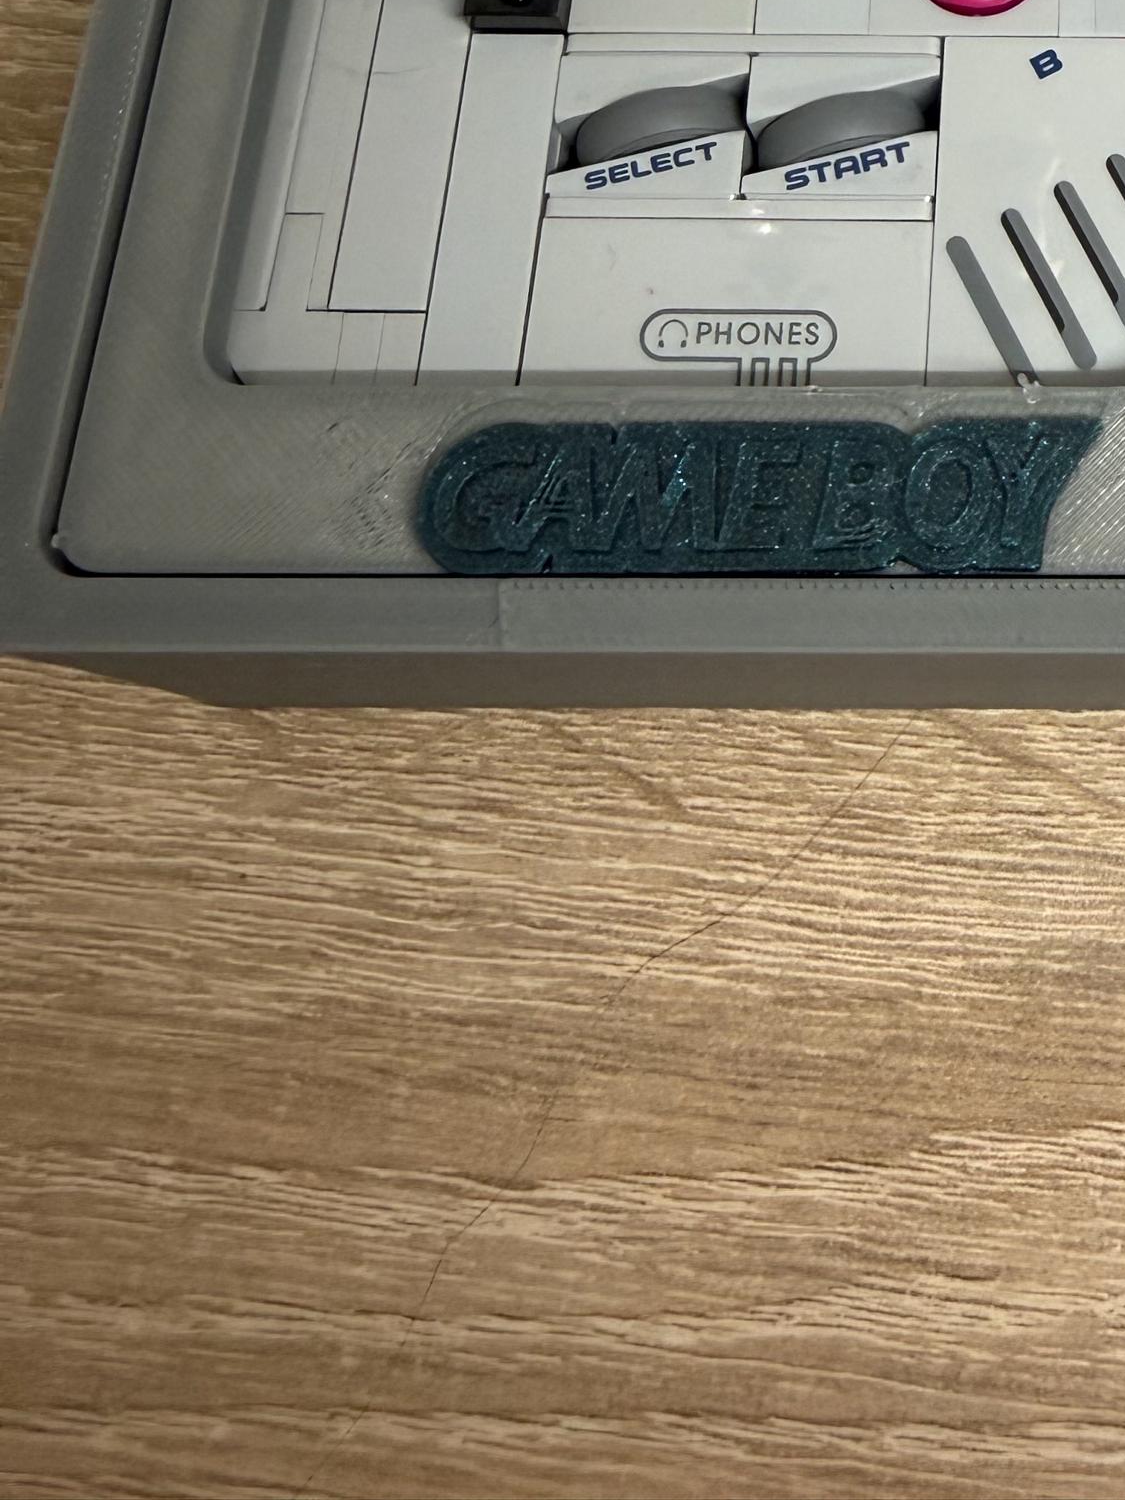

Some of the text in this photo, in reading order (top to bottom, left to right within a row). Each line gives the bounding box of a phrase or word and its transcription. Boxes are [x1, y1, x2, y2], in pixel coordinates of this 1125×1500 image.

[1029, 49, 1064, 80] B
[584, 141, 718, 191] SELECT
[784, 141, 910, 191] START
[695, 321, 820, 346] PHONES
